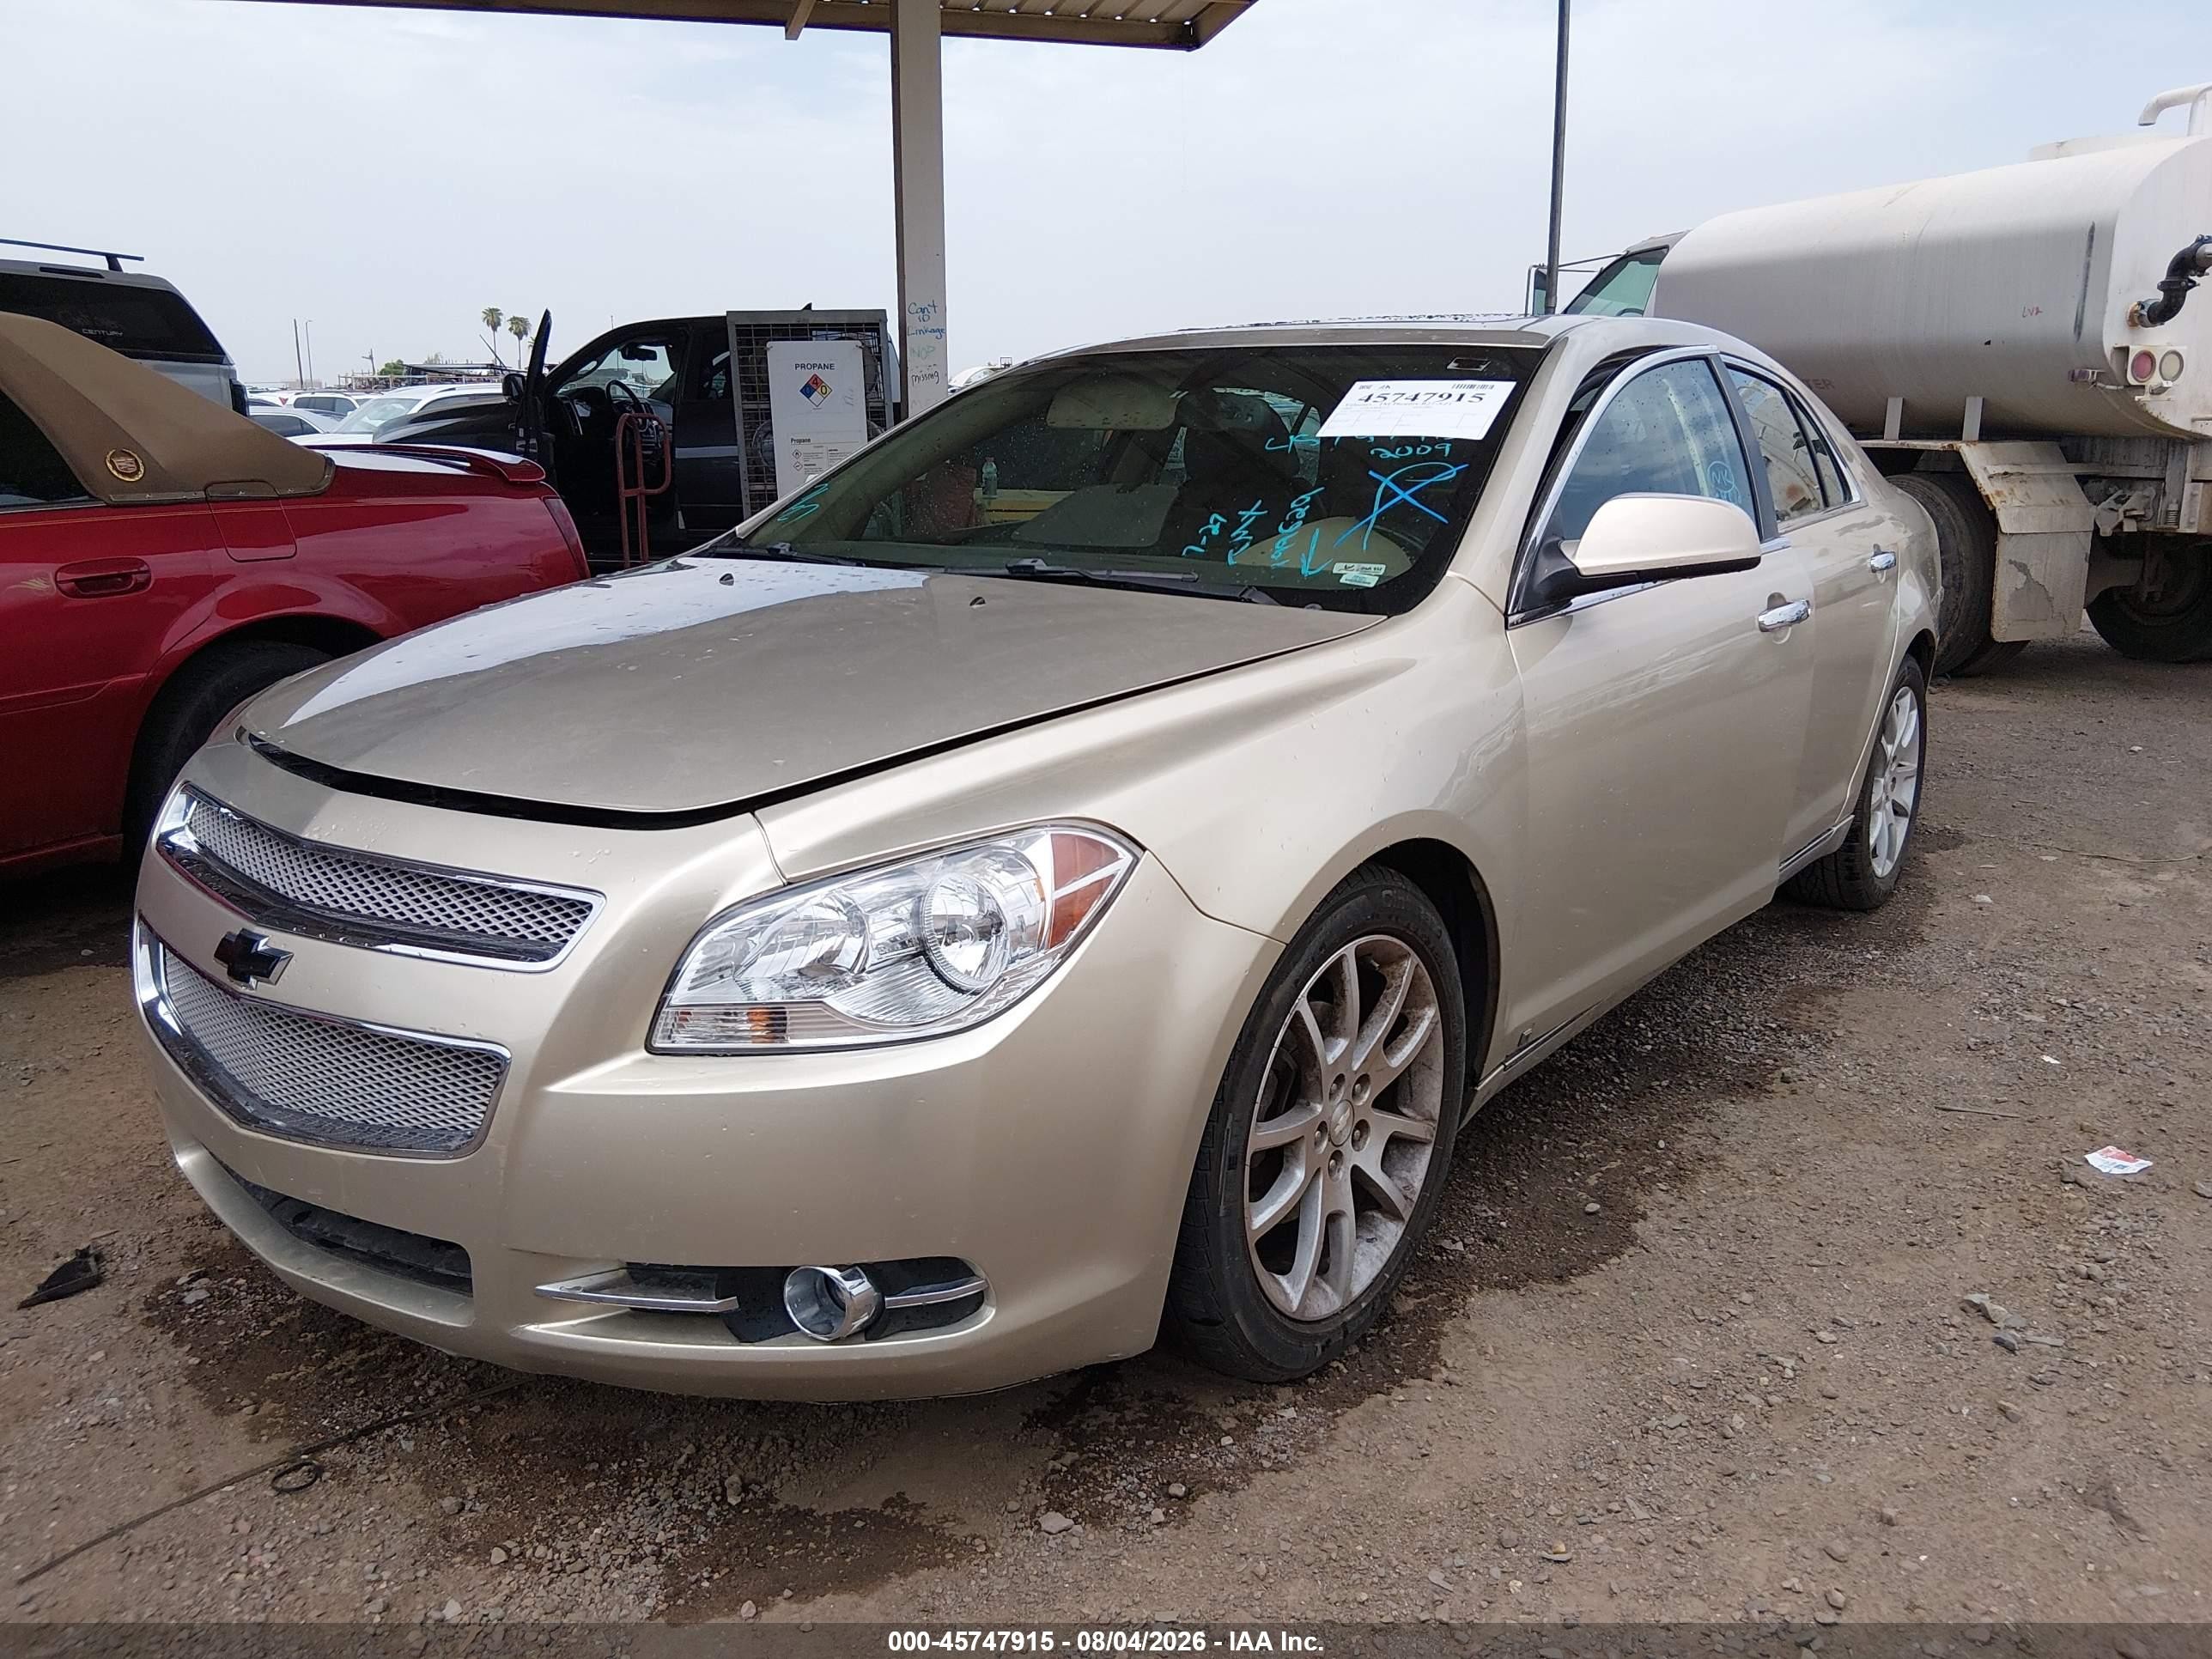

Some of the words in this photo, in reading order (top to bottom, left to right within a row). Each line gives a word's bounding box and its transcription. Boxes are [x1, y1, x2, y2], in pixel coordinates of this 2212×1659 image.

[812, 378, 819, 386] 4
[820, 385, 827, 395] 0
[1358, 392, 1486, 404] 45747915
[1370, 442, 1451, 459] 2009
